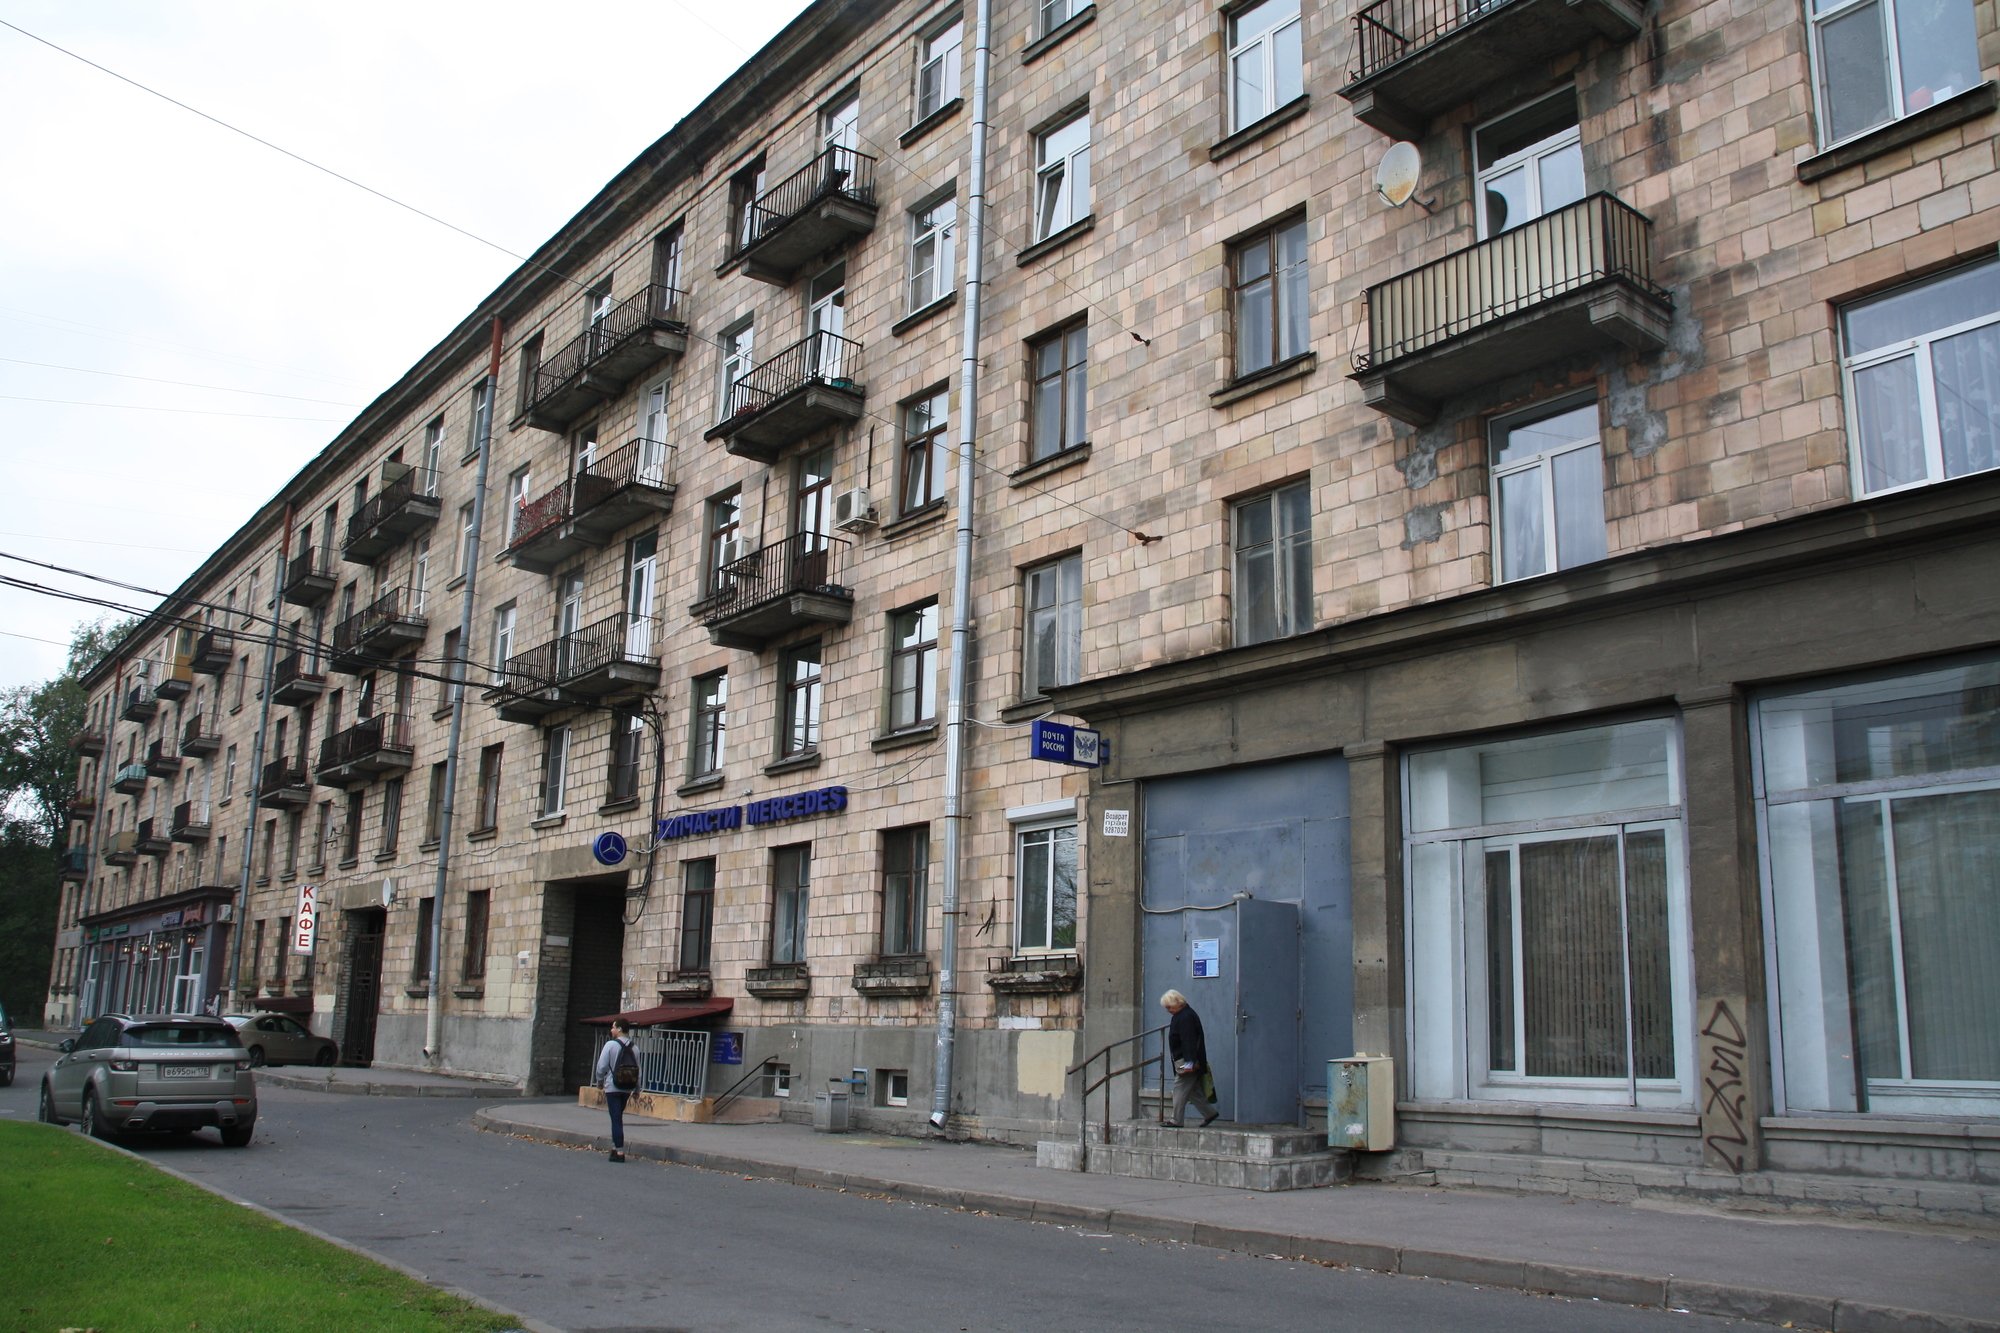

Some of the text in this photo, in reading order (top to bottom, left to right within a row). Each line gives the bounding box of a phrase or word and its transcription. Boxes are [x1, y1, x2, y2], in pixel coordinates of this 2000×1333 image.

[1042, 730, 1065, 742] ПОЧТА
[1042, 741, 1065, 753] РОССИИ
[657, 785, 848, 840] ЗАПЧАСТИ MERCEDES
[1105, 812, 1128, 821] Возврат
[298, 885, 315, 947] КАФЕ
